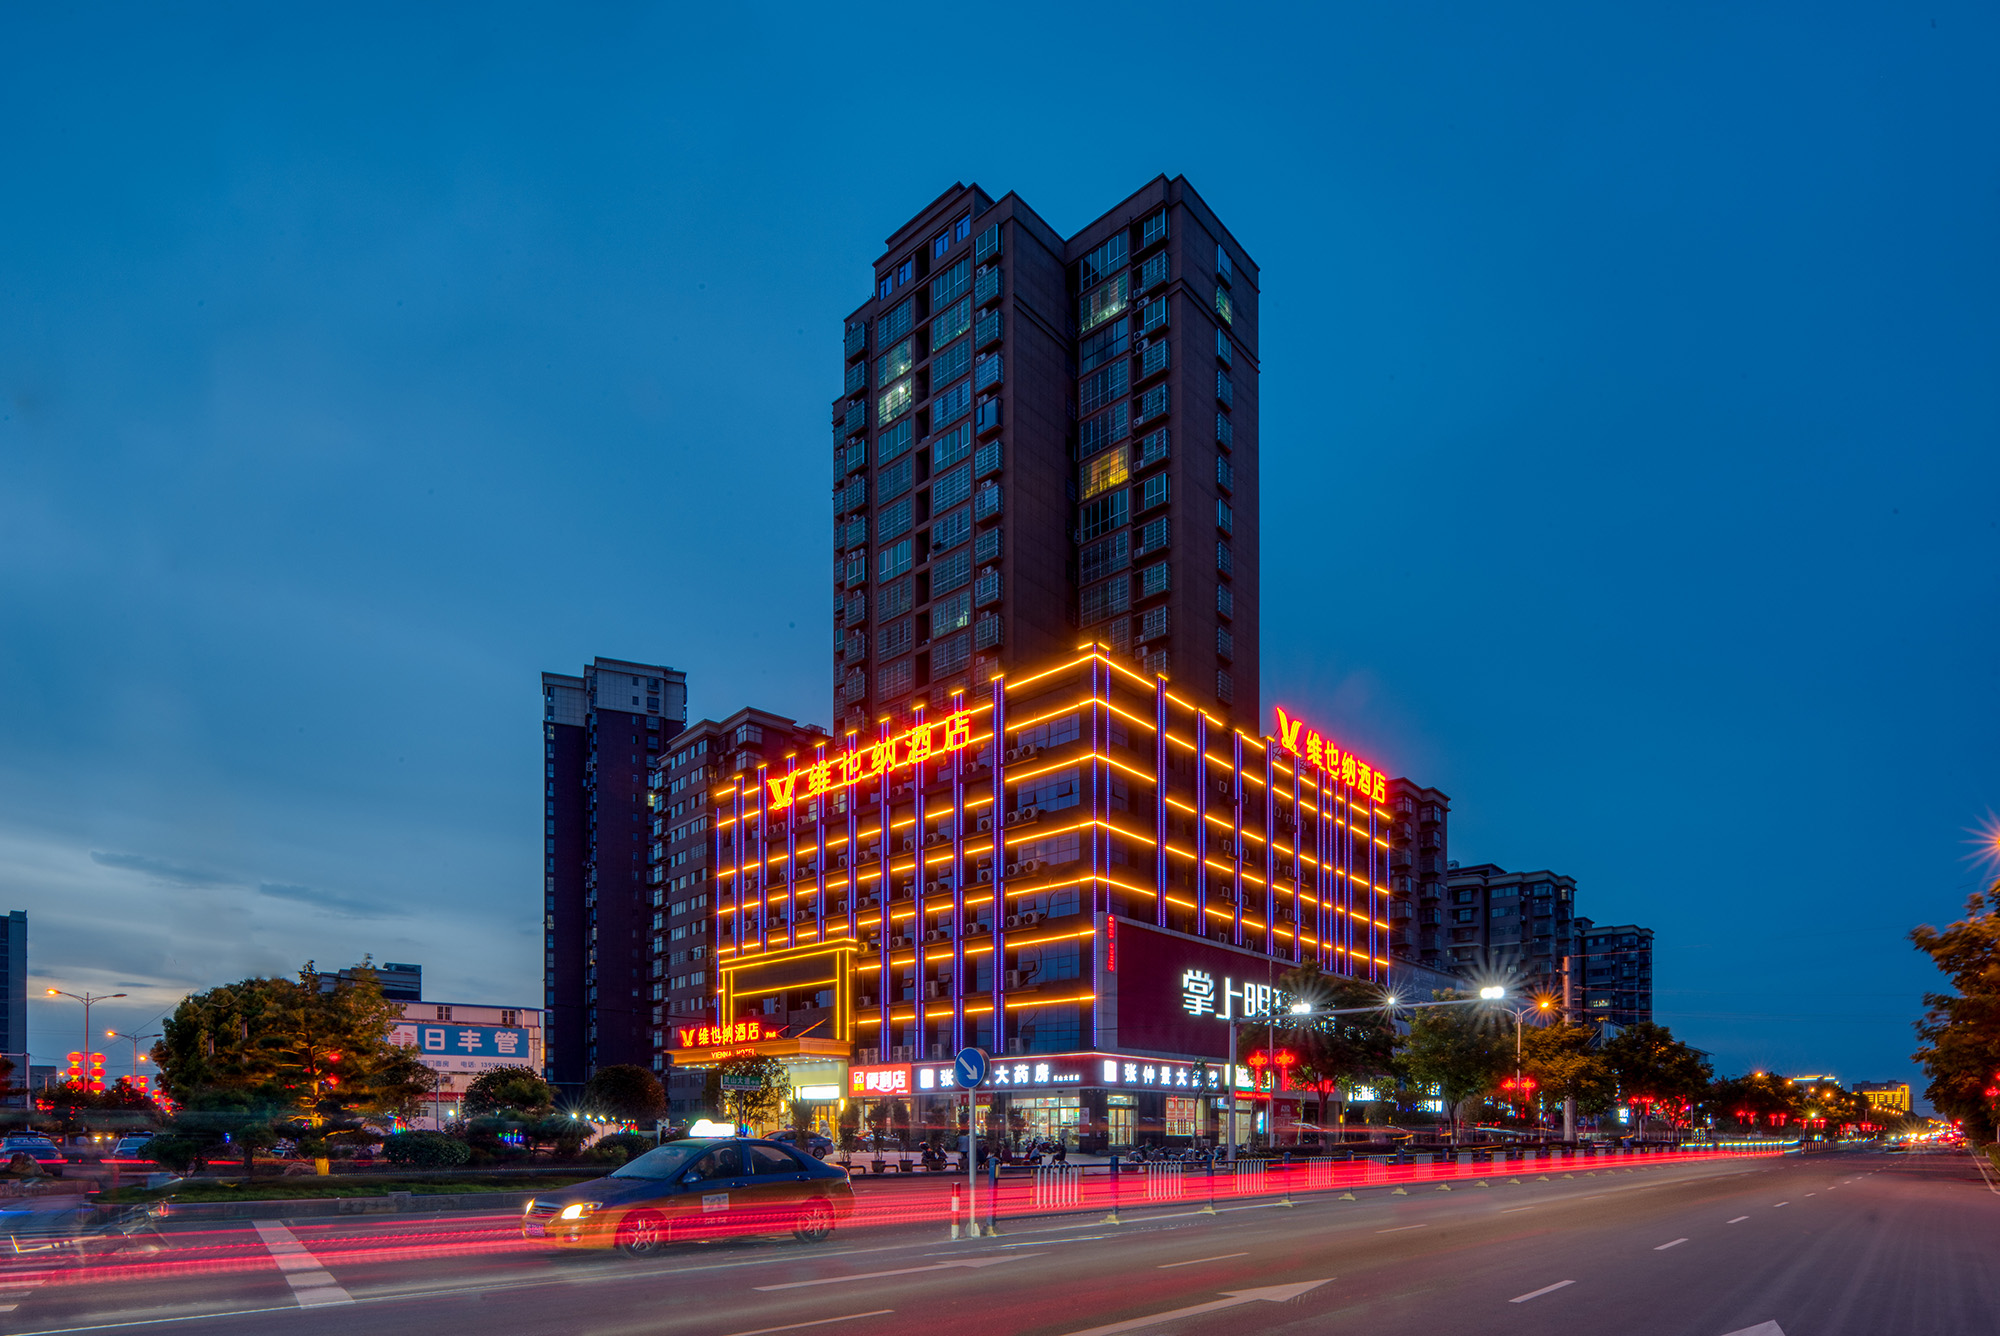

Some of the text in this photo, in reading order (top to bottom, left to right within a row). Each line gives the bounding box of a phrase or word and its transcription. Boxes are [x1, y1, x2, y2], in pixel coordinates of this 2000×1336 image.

[808, 709, 971, 796] 维也纳酒店
[1306, 730, 1386, 803] 维也纳酒店
[425, 1028, 518, 1053] 日丰管
[698, 1022, 759, 1045] 维也纳酒店
[866, 1069, 906, 1091] 便利店
[940, 1063, 1050, 1086] 张大药房
